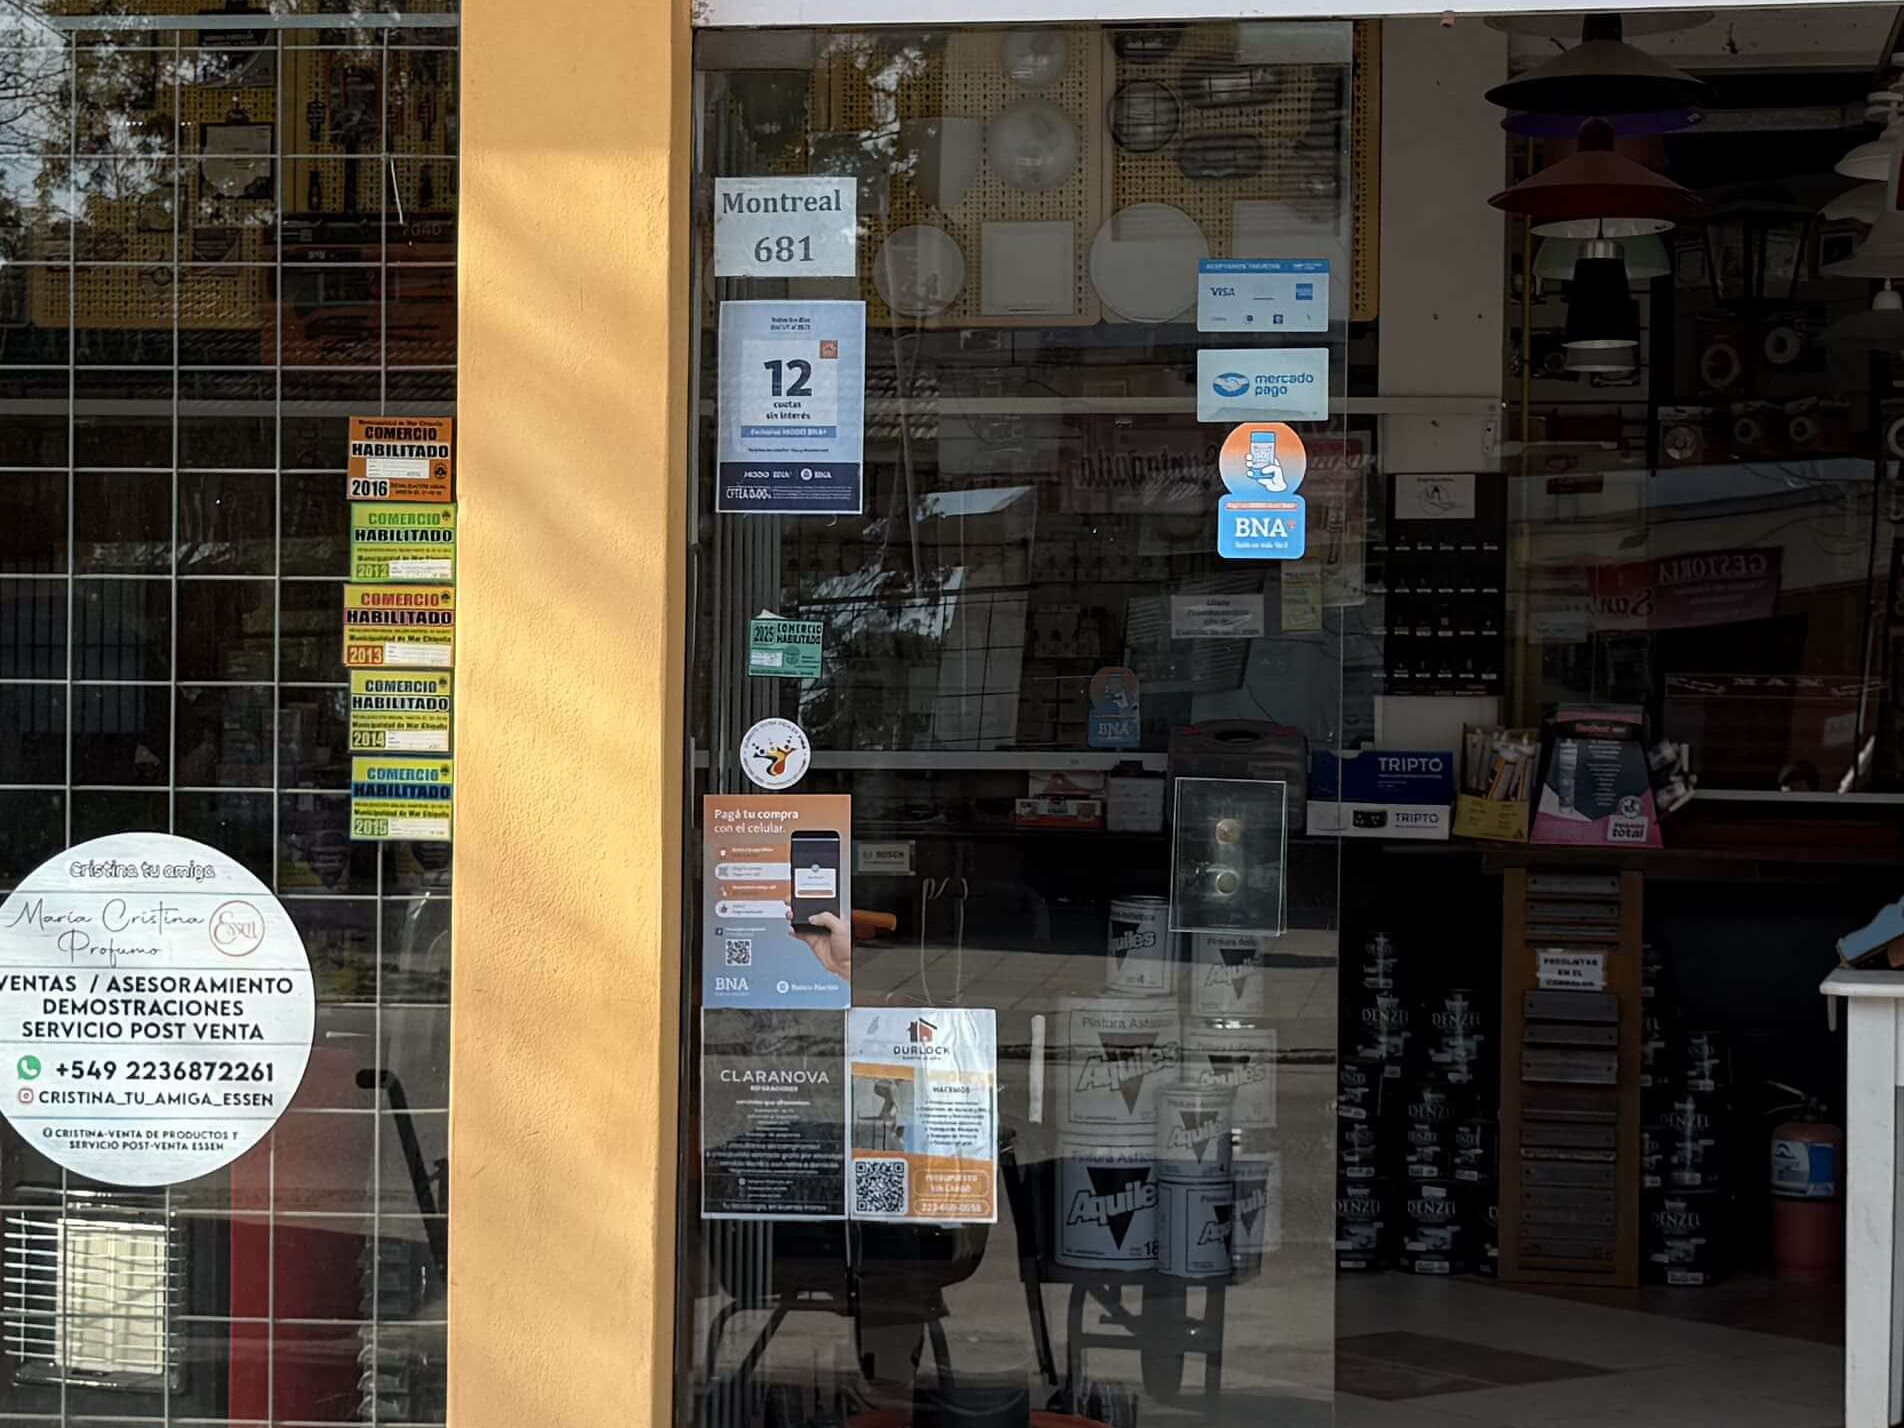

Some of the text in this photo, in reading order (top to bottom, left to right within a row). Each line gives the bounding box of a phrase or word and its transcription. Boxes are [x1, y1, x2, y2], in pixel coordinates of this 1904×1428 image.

[722, 190, 841, 214] Montreal
[754, 236, 815, 263] 681
[1210, 287, 1235, 296] VISA
[764, 359, 812, 397] 12
[1255, 373, 1314, 383] mercado
[1255, 385, 1287, 397] pago
[365, 428, 437, 440] COMERCIO
[352, 444, 448, 458] HABILITADO
[353, 480, 388, 496] 2016
[369, 513, 440, 525] COMERCIO
[355, 530, 452, 542] HABILITADO
[361, 593, 440, 606] COMERCIO
[347, 610, 452, 624] HABILITADO
[777, 623, 822, 634] COMERCIO
[777, 635, 821, 644] HABILITADO
[350, 647, 383, 663] 2013
[365, 680, 437, 692] COMERCIO
[353, 698, 449, 710] HABILITADO
[353, 731, 385, 747] 2014
[1378, 757, 1443, 772] TRIPTO
[368, 768, 439, 780] COMERCIO
[354, 784, 450, 798] HABILITADO
[714, 809, 799, 822] Pagá tu compra
[1395, 812, 1440, 823] TRIPTO
[355, 819, 388, 835] 2015
[714, 825, 733, 833] con
[735, 823, 745, 833] el
[70, 860, 215, 880] Cristina tu amiga
[5, 899, 207, 934] María Cristina
[90, 975, 98, 993] /
[107, 976, 293, 994] ASESORAMIENTO
[715, 978, 748, 991] BNA
[44, 999, 243, 1016] DEMOSTRACIONES
[23, 1022, 264, 1040] SERVICIO POST VENTA
[893, 1046, 951, 1055] DURLOCK
[56, 1061, 273, 1081] +549 2236872261
[720, 1070, 829, 1084] CLARANOVA
[39, 1091, 273, 1107] CRISTINA_TU_AMIGA_ESSEN
[146, 1130, 159, 1139] DE
[163, 1130, 228, 1140] PRODUCTOS
[70, 1141, 119, 1150] SERVICIO
[1067, 1181, 1158, 1226] Aquile
